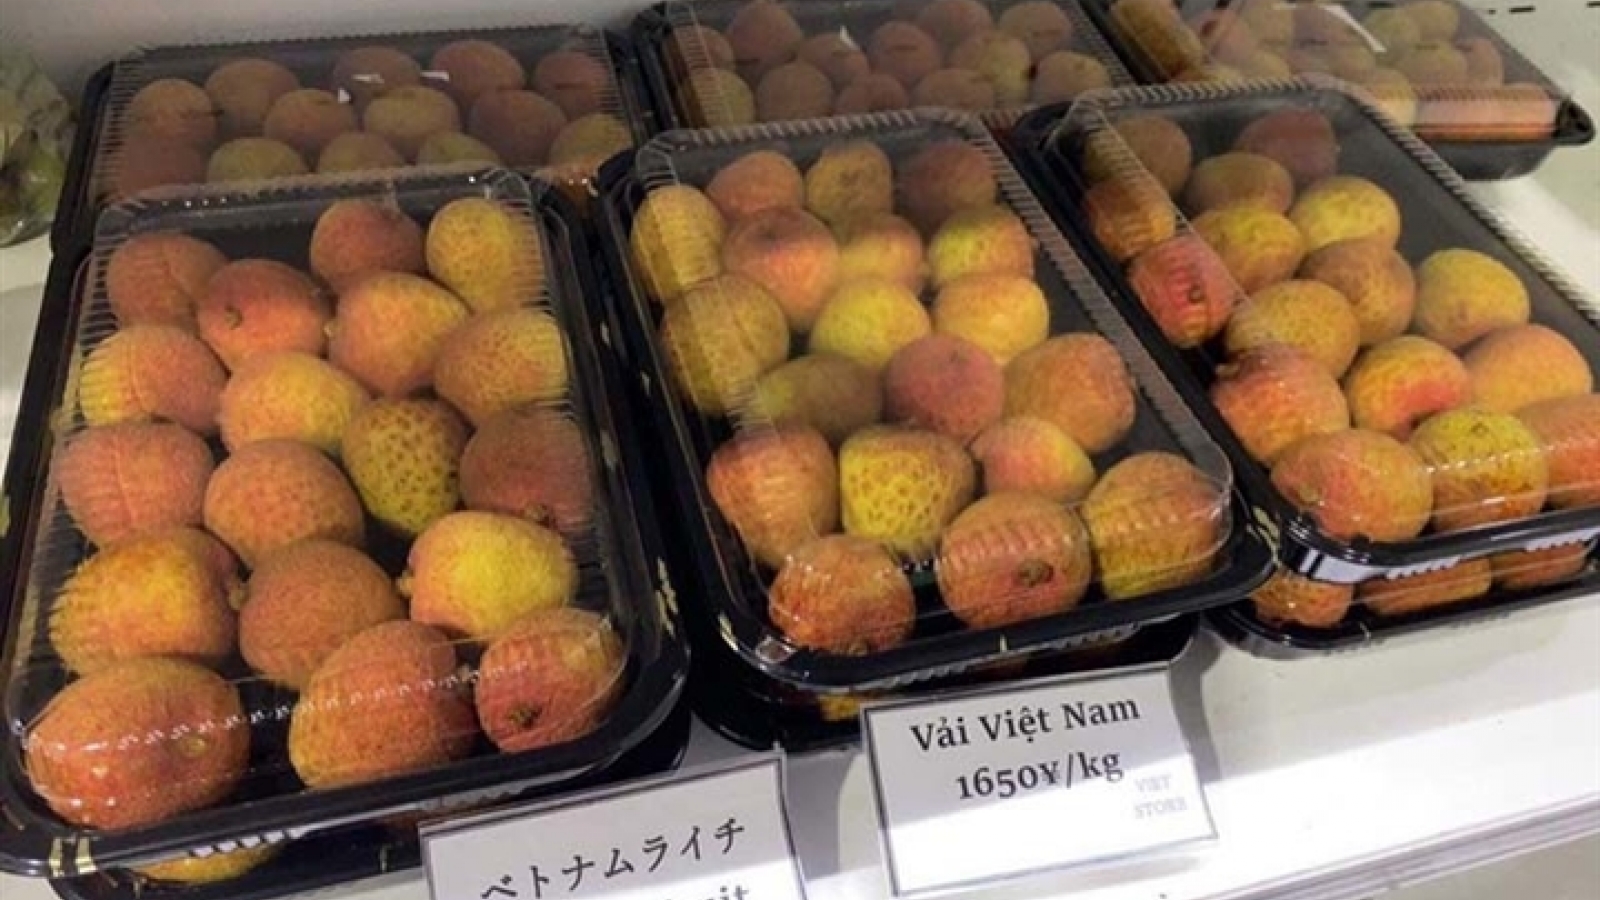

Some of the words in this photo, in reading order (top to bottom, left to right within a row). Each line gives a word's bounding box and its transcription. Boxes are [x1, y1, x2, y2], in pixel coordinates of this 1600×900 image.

[910, 716, 970, 752] Vải
[978, 705, 1052, 744] Việt
[1061, 698, 1140, 730] Nam
